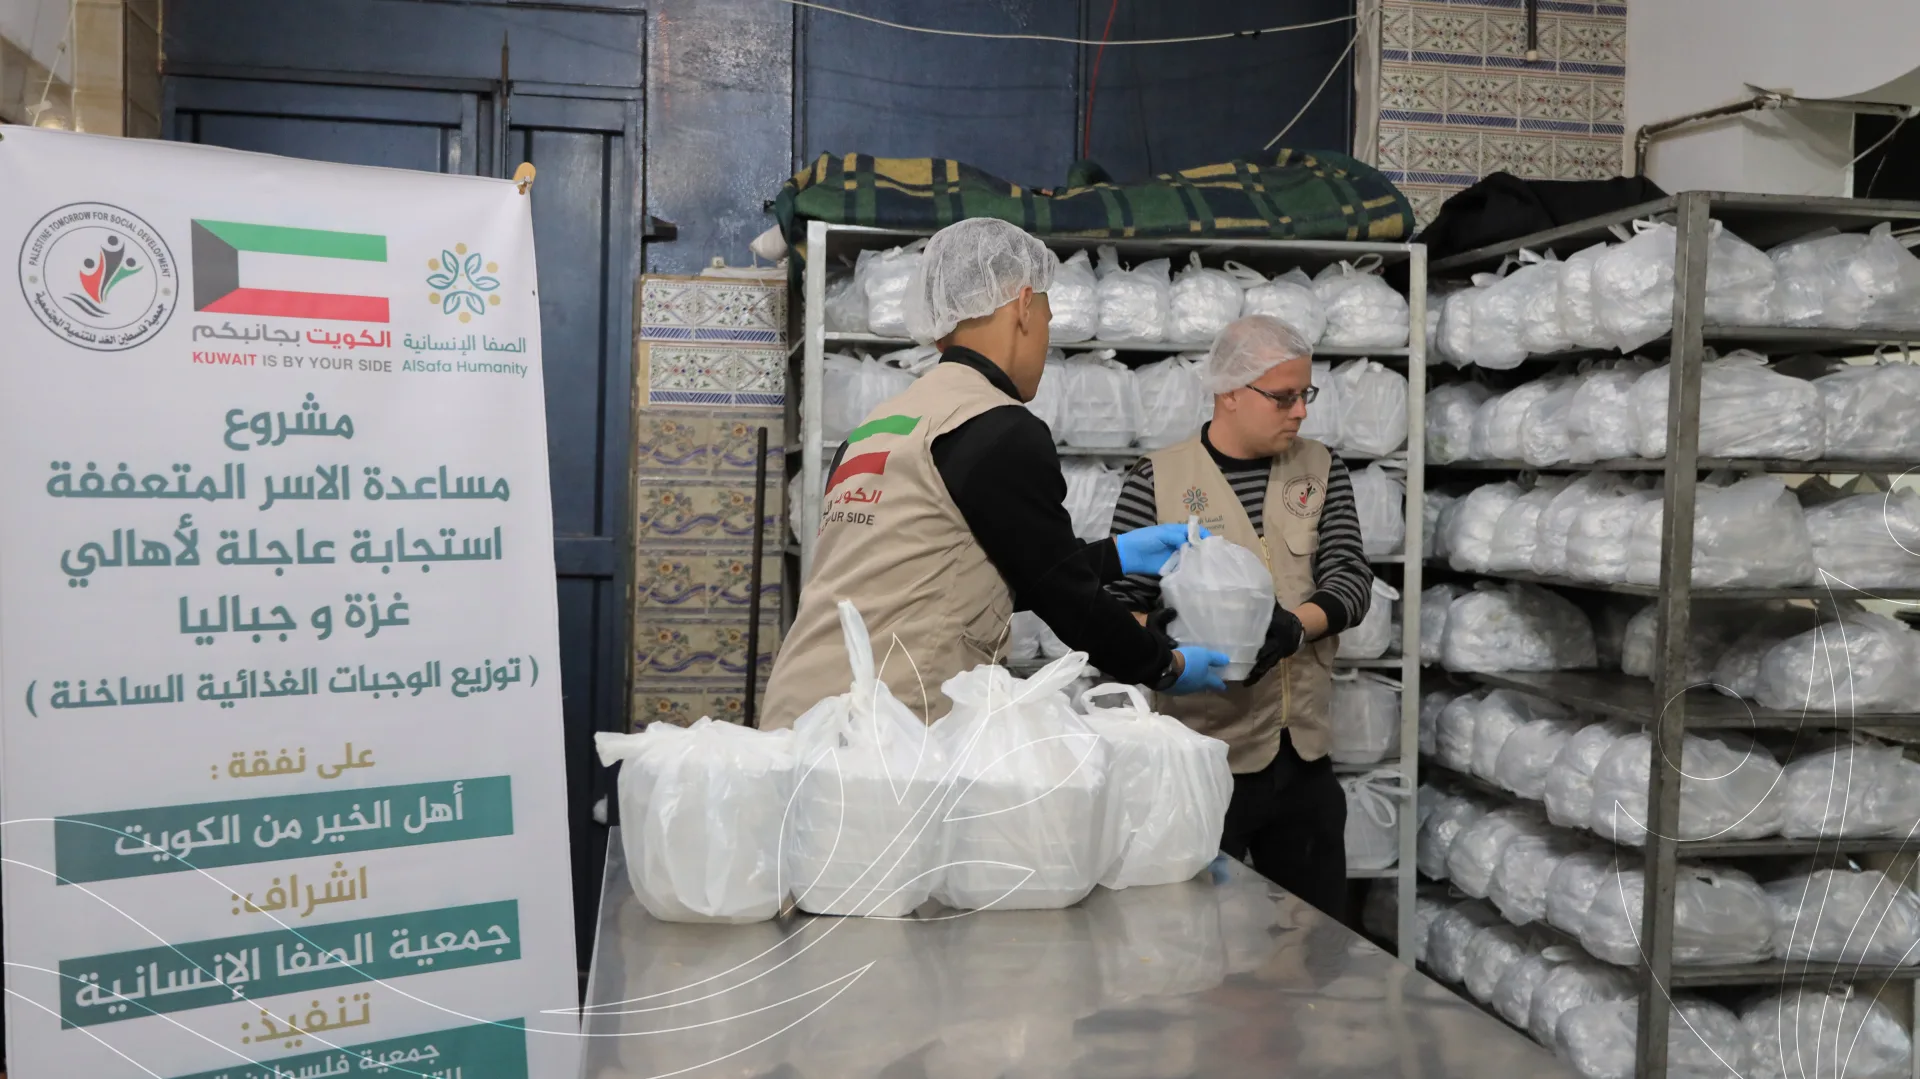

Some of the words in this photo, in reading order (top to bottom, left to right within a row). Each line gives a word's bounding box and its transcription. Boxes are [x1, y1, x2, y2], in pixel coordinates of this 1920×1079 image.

[29, 229, 52, 266] PALESTINE
[49, 211, 91, 232] TOMORROW
[92, 211, 109, 221] FOR
[110, 214, 137, 233] SOCIAL
[137, 229, 171, 278] DEVELOPMENT
[118, 323, 149, 345] فلسطين
[148, 302, 168, 326] جمعية
[192, 321, 300, 348] بجانبكم
[306, 328, 392, 350] الكويت
[403, 332, 477, 356] الإنسانية
[483, 334, 527, 354] الصفا
[192, 351, 257, 367] KUWAIT
[262, 354, 278, 368] IS
[283, 355, 304, 369] BY
[309, 357, 354, 371] YOUR
[358, 359, 393, 373] SIDE
[402, 359, 453, 373] AlSafa
[456, 360, 528, 379] Humanity
[223, 392, 355, 451] مشروع
[46, 460, 246, 502] المتعففة
[258, 464, 351, 511] الاسر
[363, 465, 511, 502] مساعدة
[846, 511, 875, 526] SIDE
[60, 512, 201, 588] لأهالي
[216, 528, 336, 577] عاجلة
[350, 526, 503, 574] استجابة
[179, 595, 298, 646] جباليا
[310, 604, 334, 641] و
[344, 592, 411, 639] غزة
[50, 674, 184, 711] الساخنة
[196, 667, 318, 709] الغذائية
[328, 660, 441, 700] الوجبات
[451, 657, 522, 698] توزيع
[228, 746, 308, 780] نفقة
[316, 742, 376, 780] على
[315, 799, 392, 845] الخير
[403, 781, 465, 835] أهل
[114, 814, 241, 862] الكويت
[253, 813, 302, 849] من
[231, 860, 368, 917] اشراف:
[275, 932, 375, 975] الصفا
[388, 924, 512, 968] جمعية
[75, 947, 260, 1015] الإنسانية
[240, 992, 372, 1049] تنفيذ:
[358, 1043, 441, 1075] جمعية
